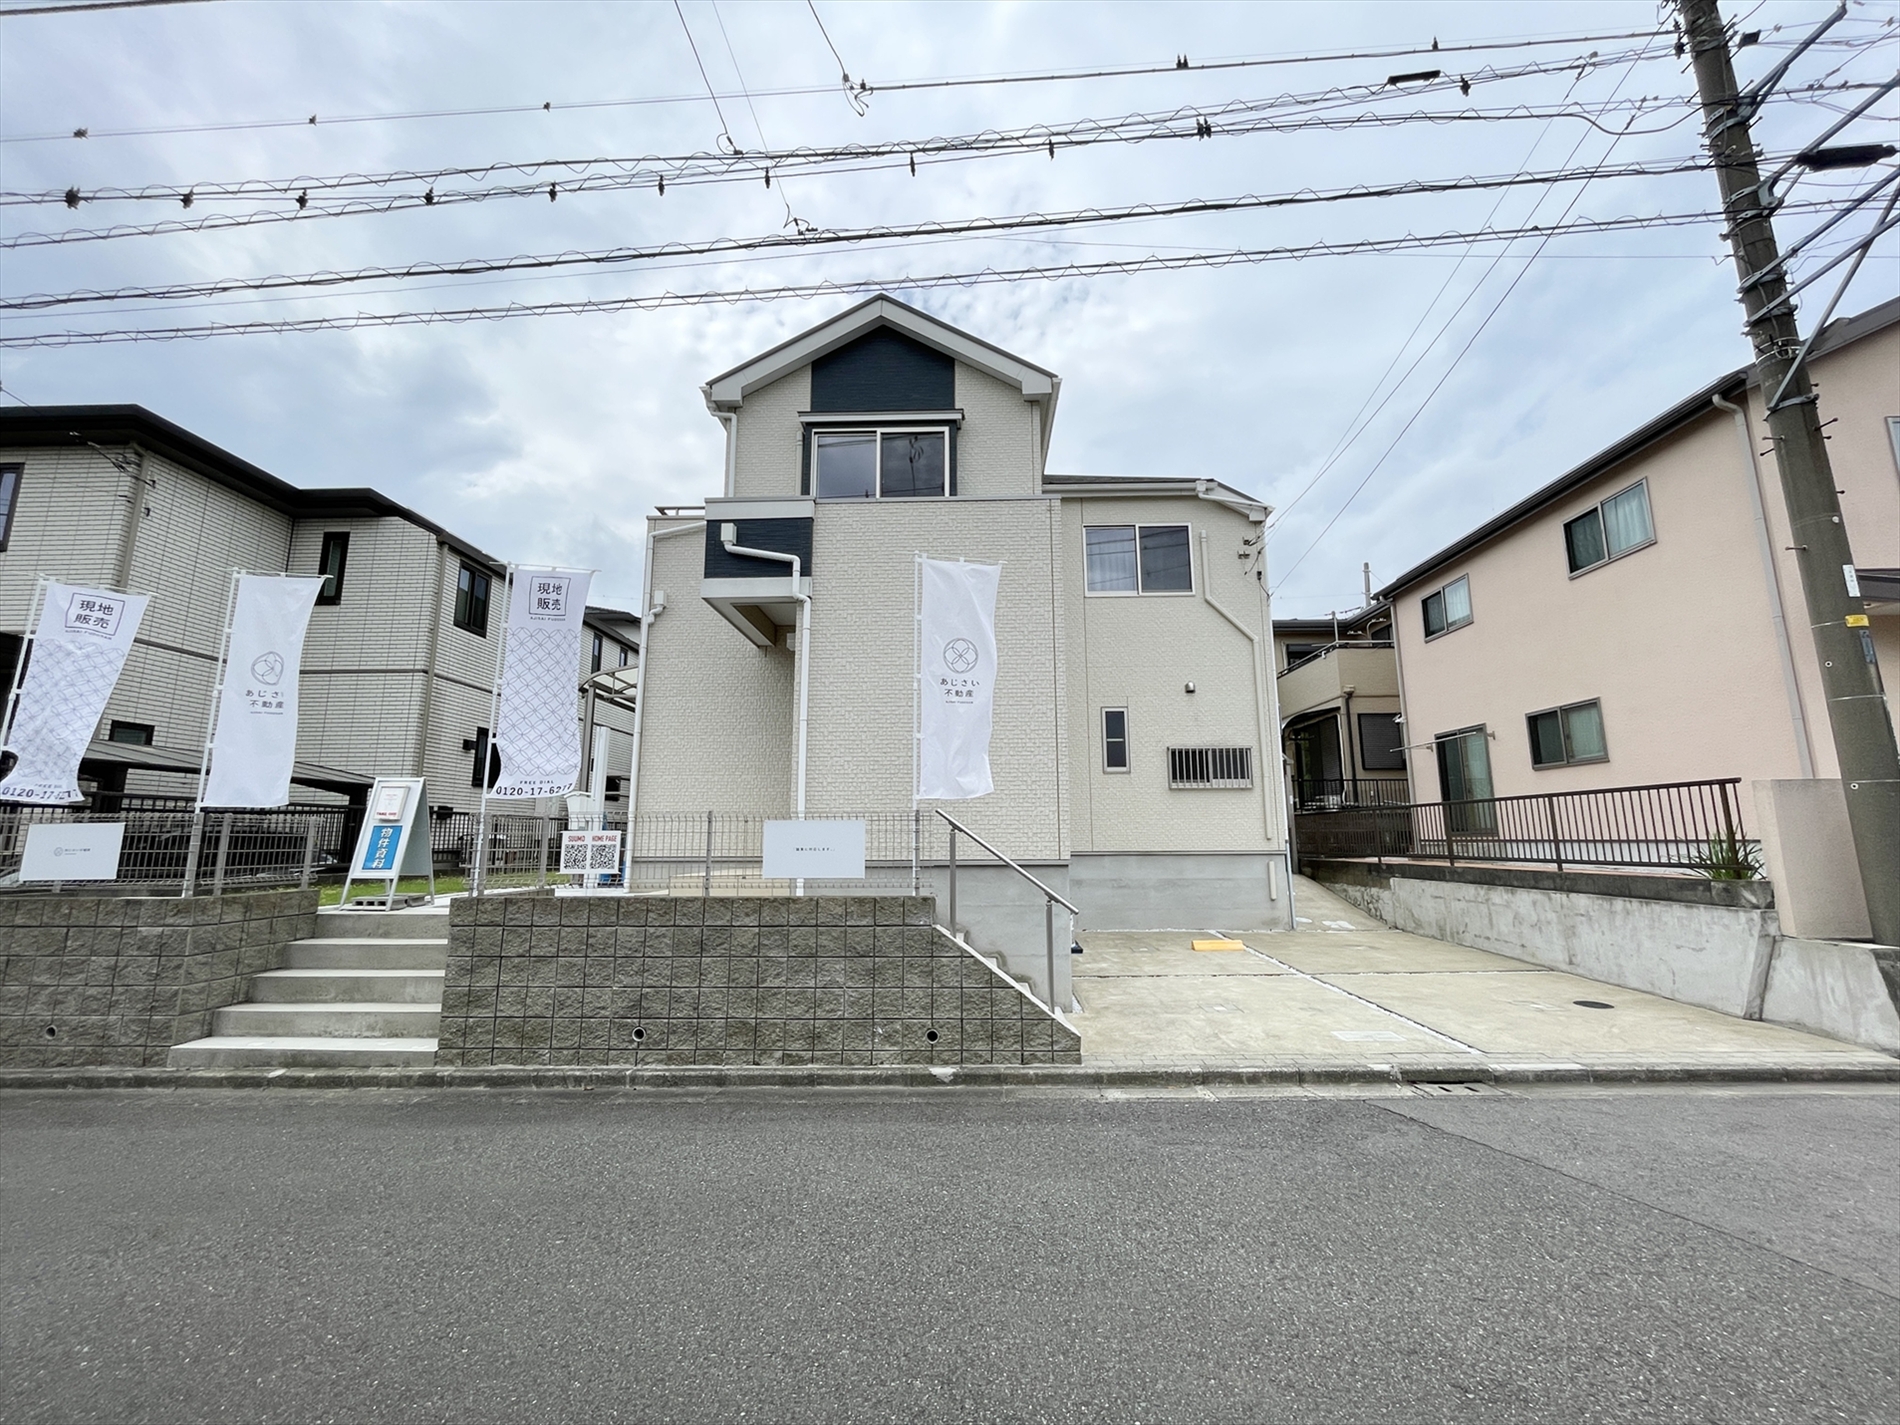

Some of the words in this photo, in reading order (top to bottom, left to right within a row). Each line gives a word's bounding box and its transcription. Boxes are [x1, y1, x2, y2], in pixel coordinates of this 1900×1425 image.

[537, 582, 563, 596] 現地
[79, 599, 114, 616] 現地
[536, 597, 561, 611] 販売
[73, 613, 111, 629] 販売
[940, 678, 980, 687] あじさい
[944, 688, 974, 698] 不動産
[249, 699, 284, 709] 不動産
[495, 783, 573, 796] 0120-17-6277
[568, 835, 586, 843] SUUMO
[372, 827, 393, 869] 物件資料
